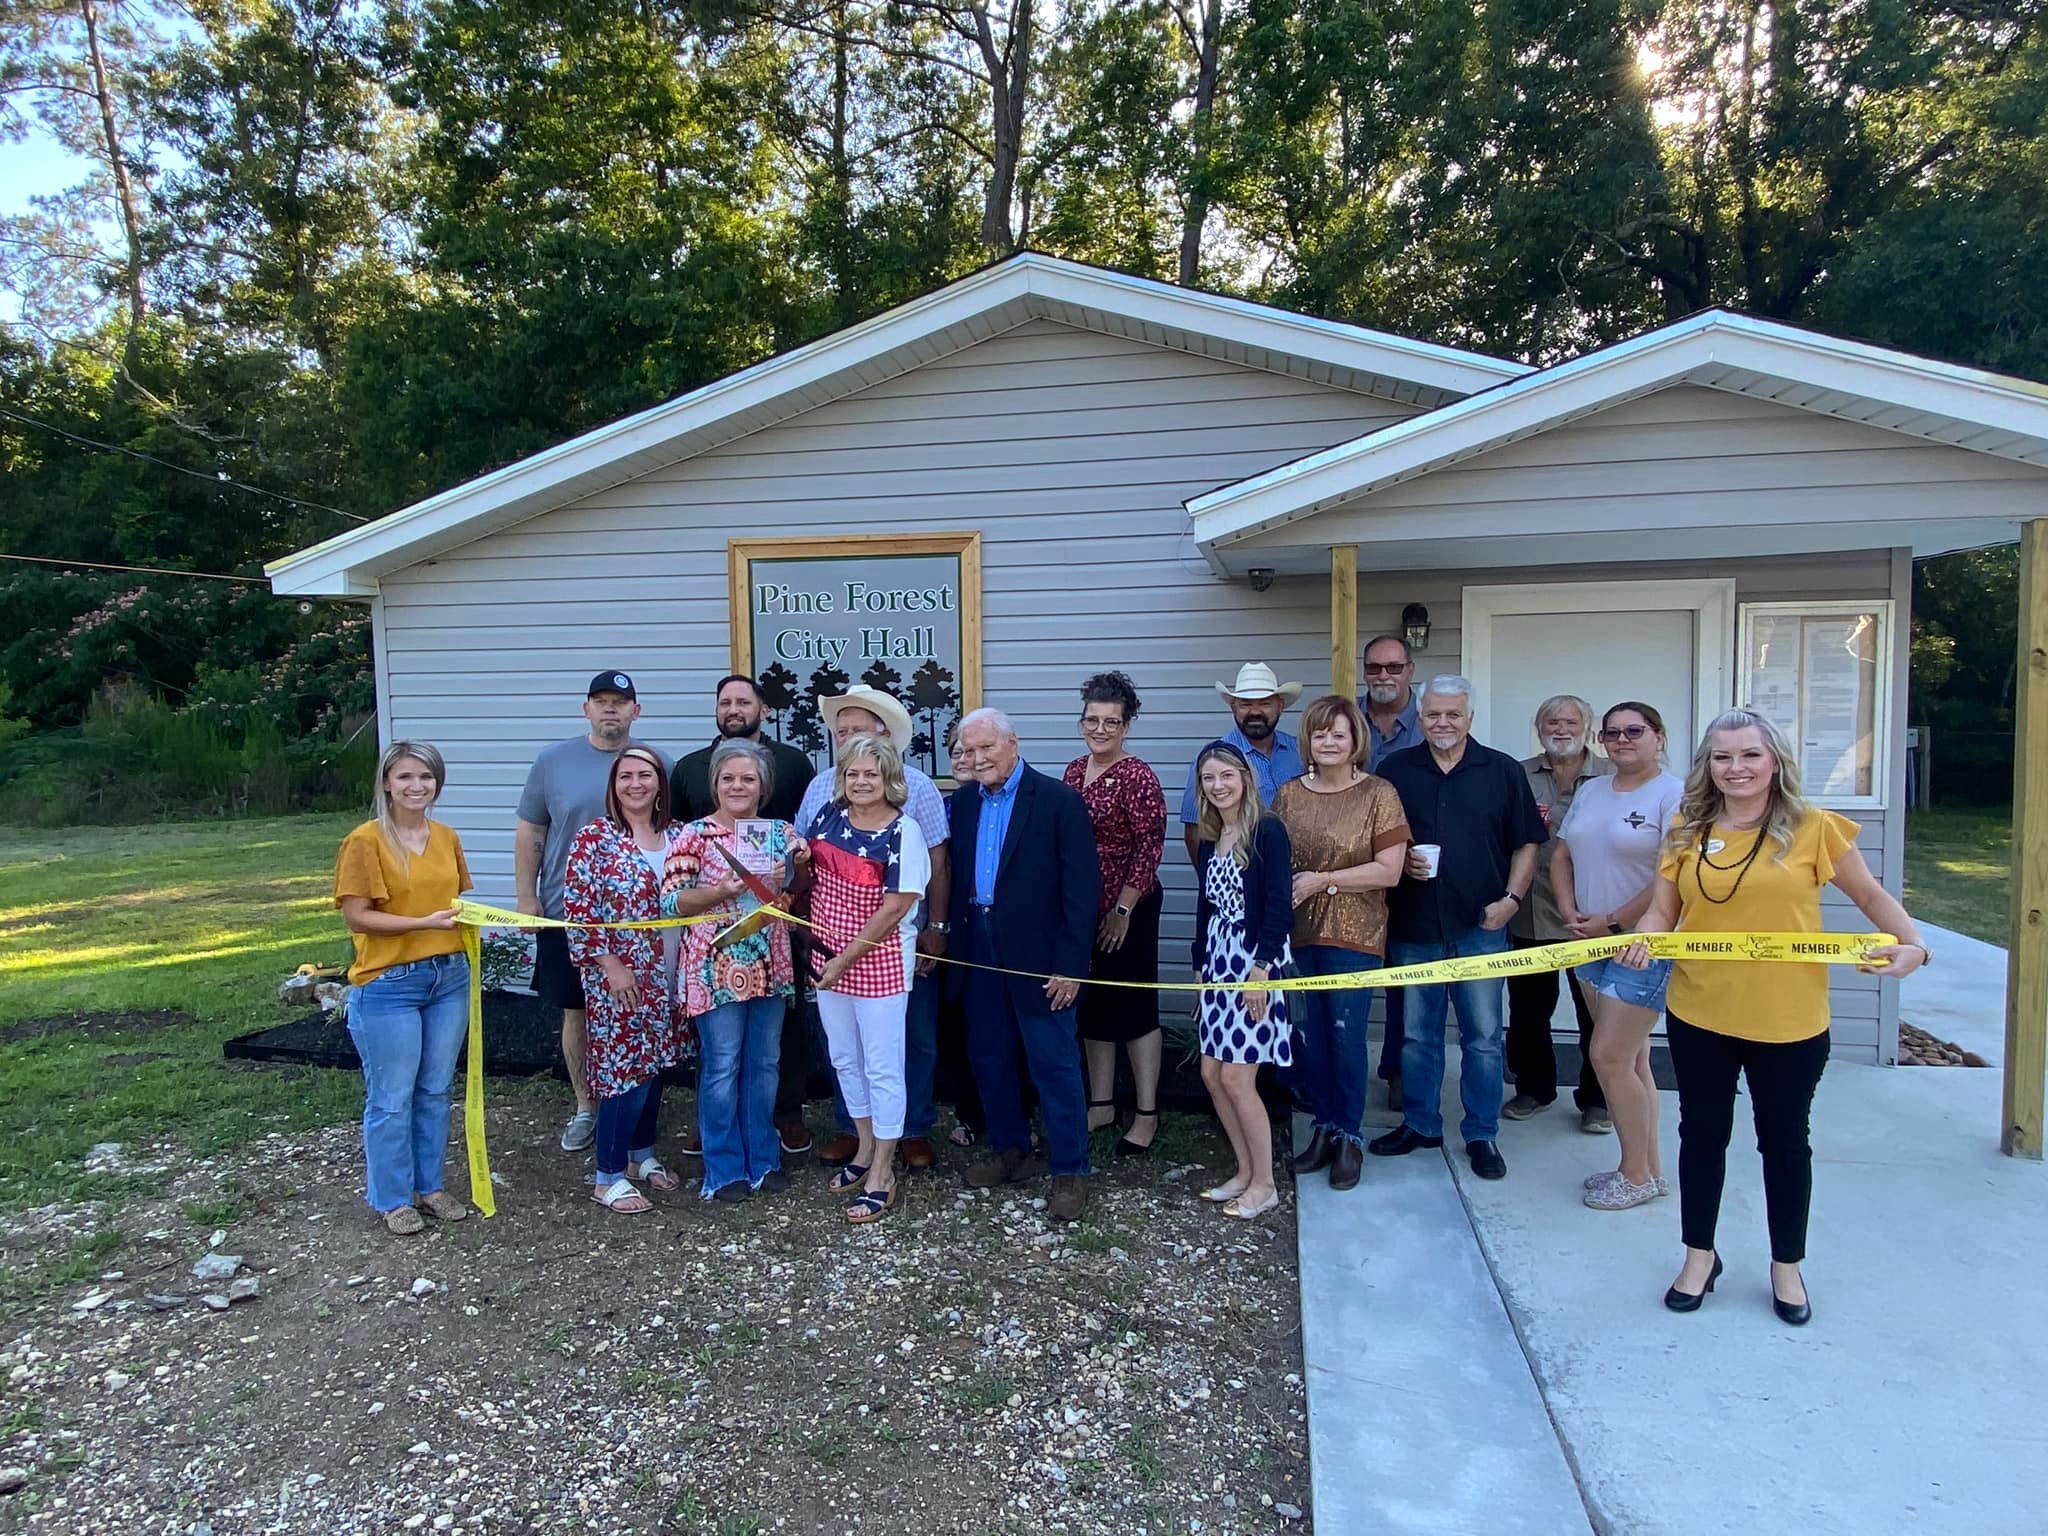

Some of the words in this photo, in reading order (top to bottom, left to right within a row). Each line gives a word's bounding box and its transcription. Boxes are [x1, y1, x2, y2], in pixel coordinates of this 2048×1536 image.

[757, 583, 833, 614] Pine
[845, 581, 955, 612] Forest
[774, 629, 849, 670] City
[859, 626, 937, 659] Hall
[1685, 942, 1733, 952] MEMBER
[1791, 943, 1841, 955] MEMBER
[1487, 956, 1533, 970] MEMBER
[1390, 969, 1434, 980] MEMBER
